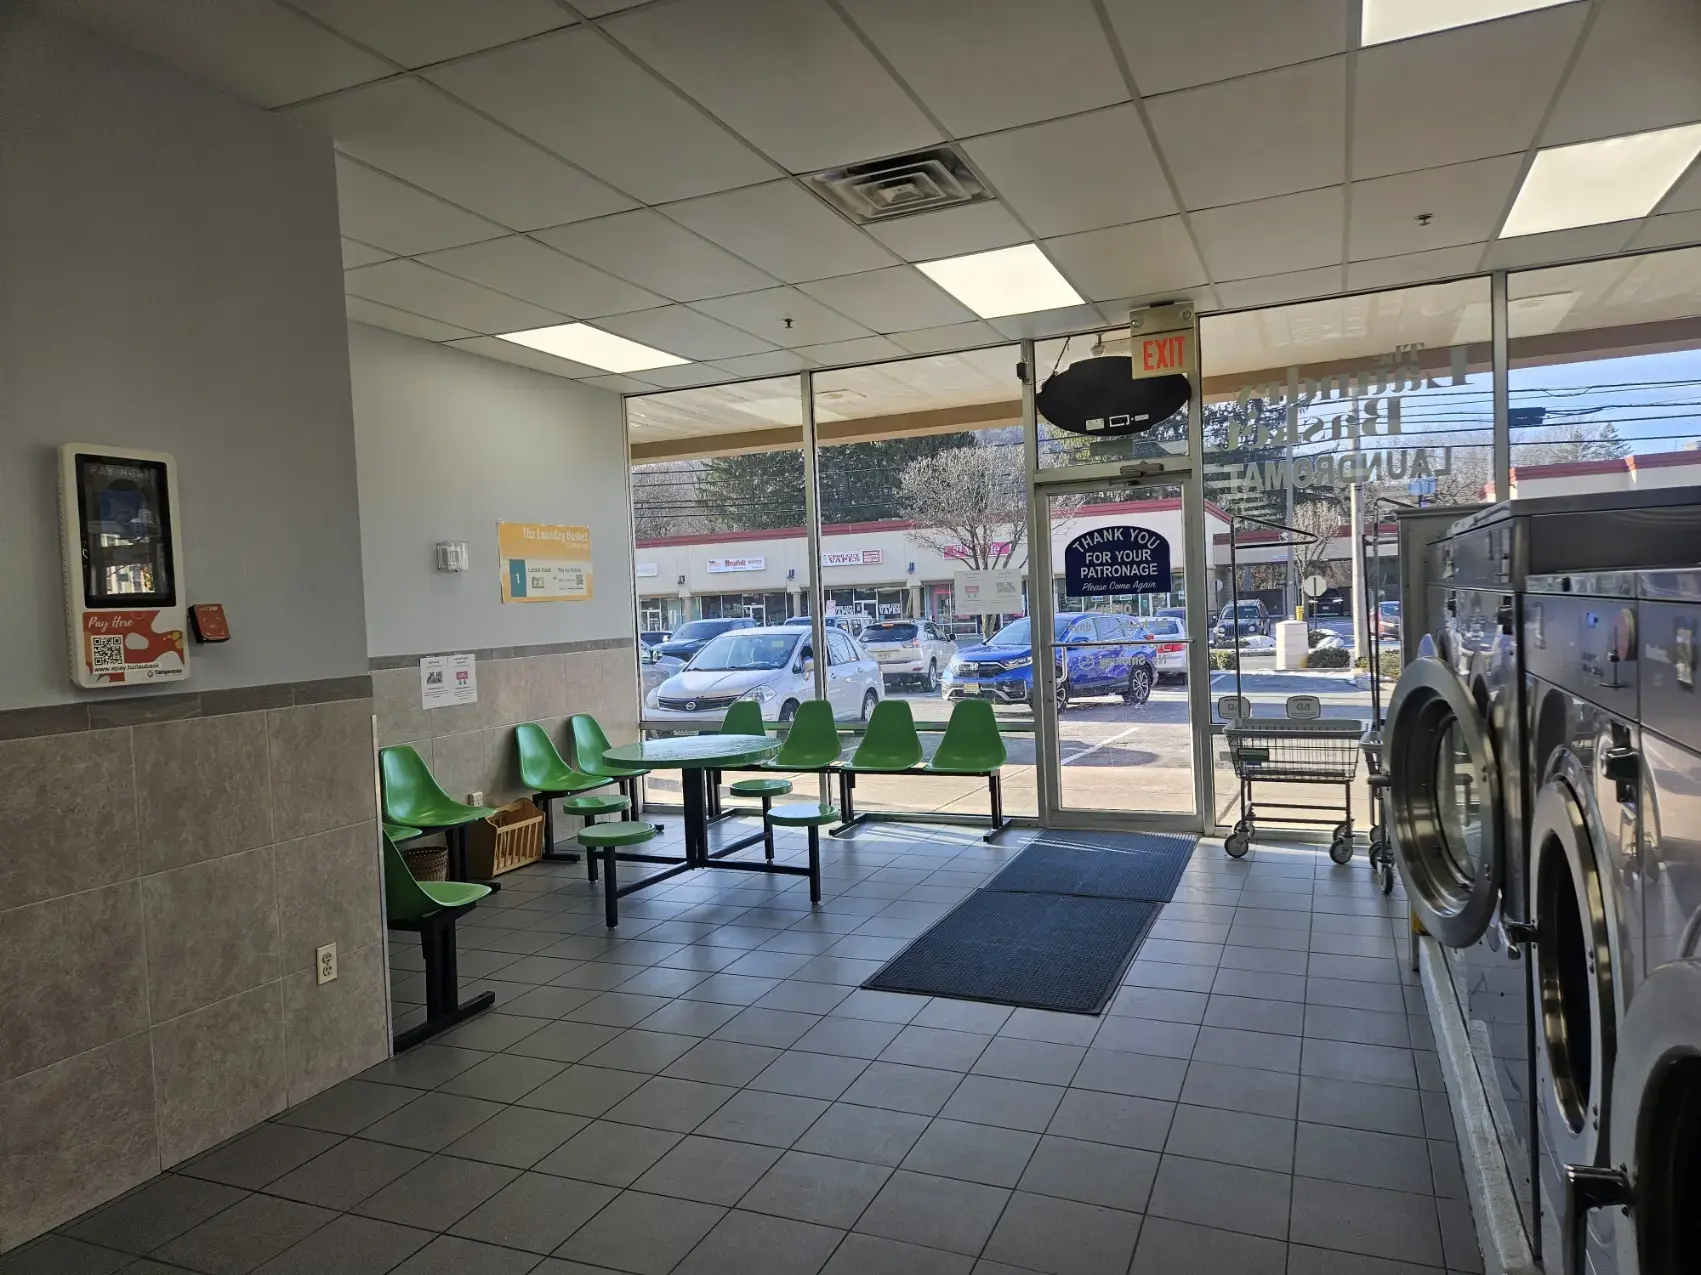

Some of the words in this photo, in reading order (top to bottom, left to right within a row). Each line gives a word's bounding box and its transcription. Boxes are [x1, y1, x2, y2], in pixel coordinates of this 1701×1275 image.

[1143, 336, 1185, 371] EXIT
[537, 528, 565, 543] Laundry
[566, 531, 589, 541] Basket
[1072, 528, 1124, 553] THANK
[1130, 528, 1160, 549] YOU
[1085, 551, 1111, 564] FOR
[1115, 549, 1152, 562] YOUR
[515, 573, 521, 584] 1
[1080, 563, 1158, 579] PATRONAGE
[1082, 581, 1108, 592] Please
[1109, 580, 1131, 590] Come
[1132, 580, 1156, 592] Again
[88, 616, 108, 632] Pay
[111, 615, 135, 629] Here
